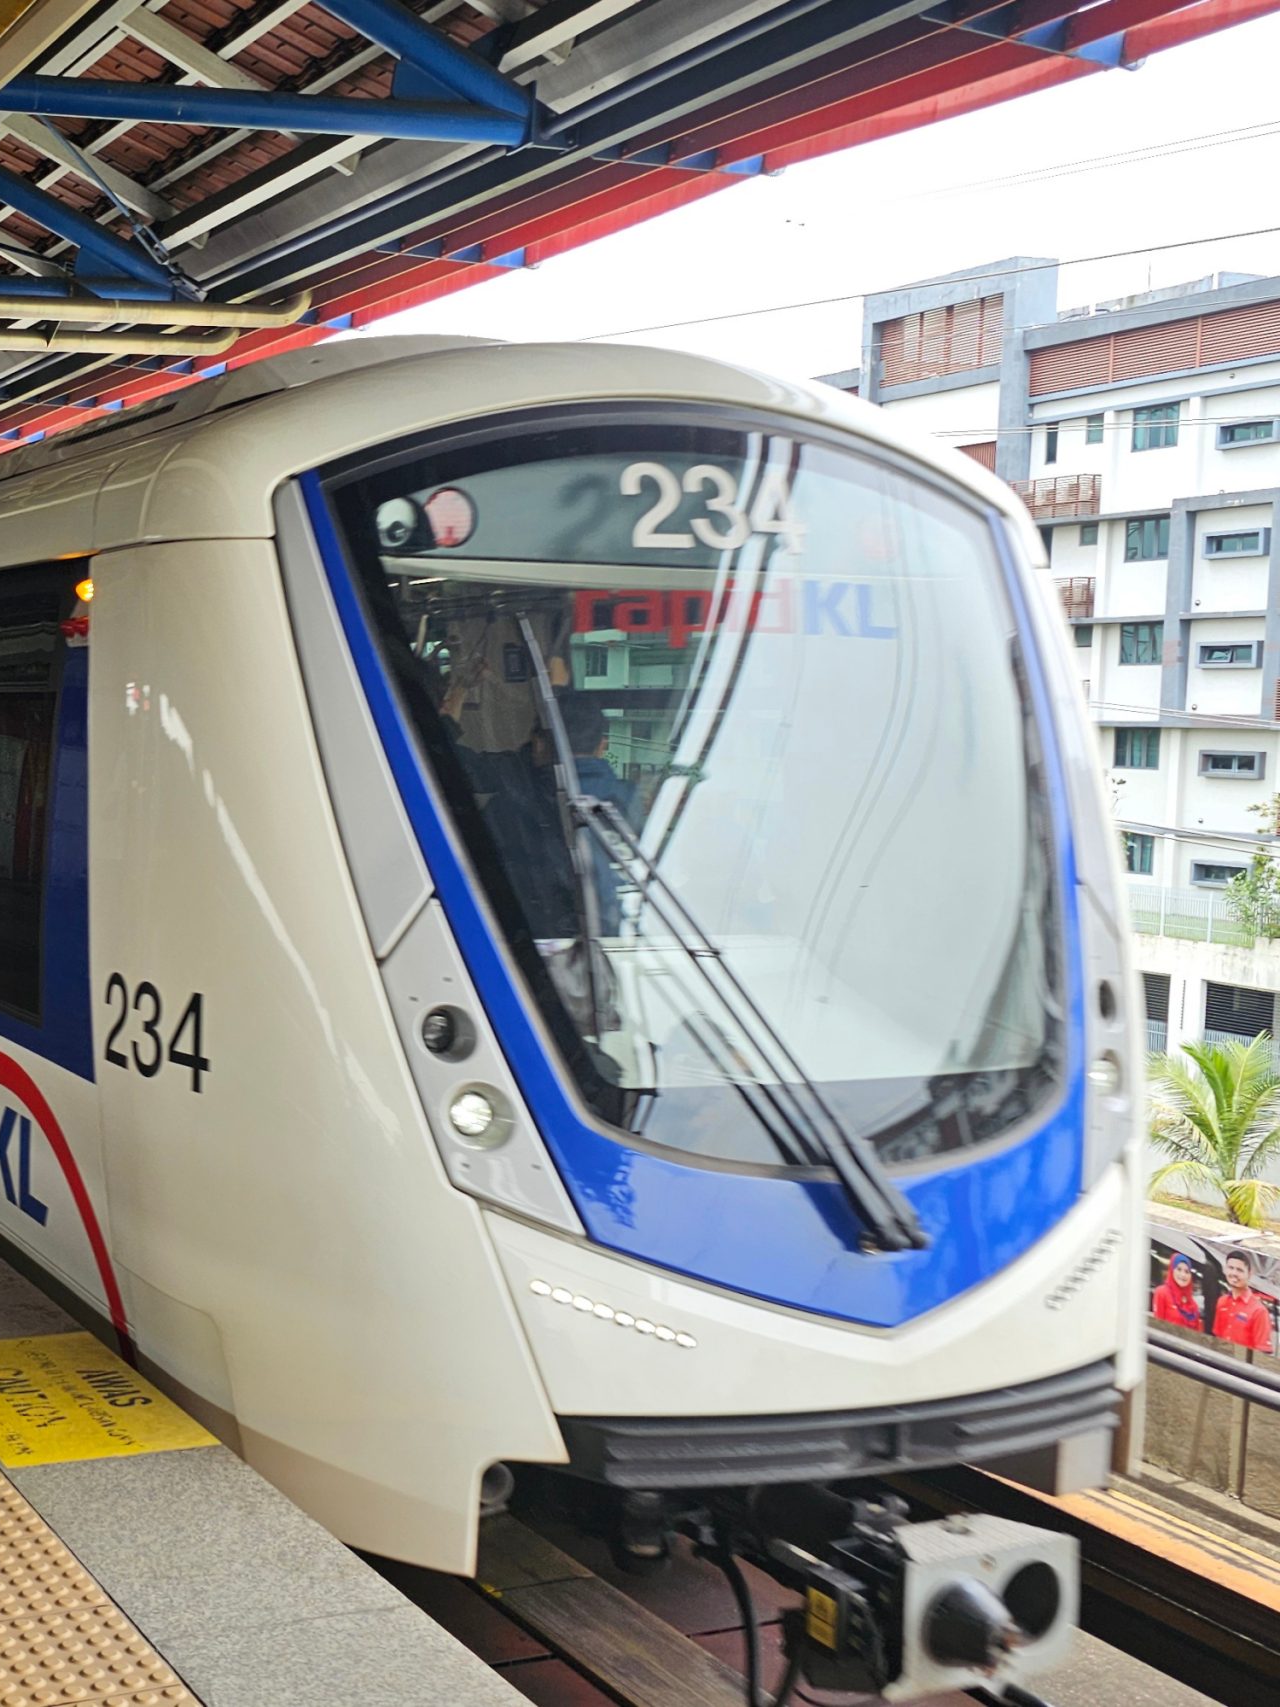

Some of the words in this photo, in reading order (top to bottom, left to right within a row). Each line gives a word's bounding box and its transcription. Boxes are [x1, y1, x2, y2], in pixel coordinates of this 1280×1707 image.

[619, 461, 808, 555] 234
[104, 971, 211, 1094] 234
[75, 1368, 153, 1409] AWAS
